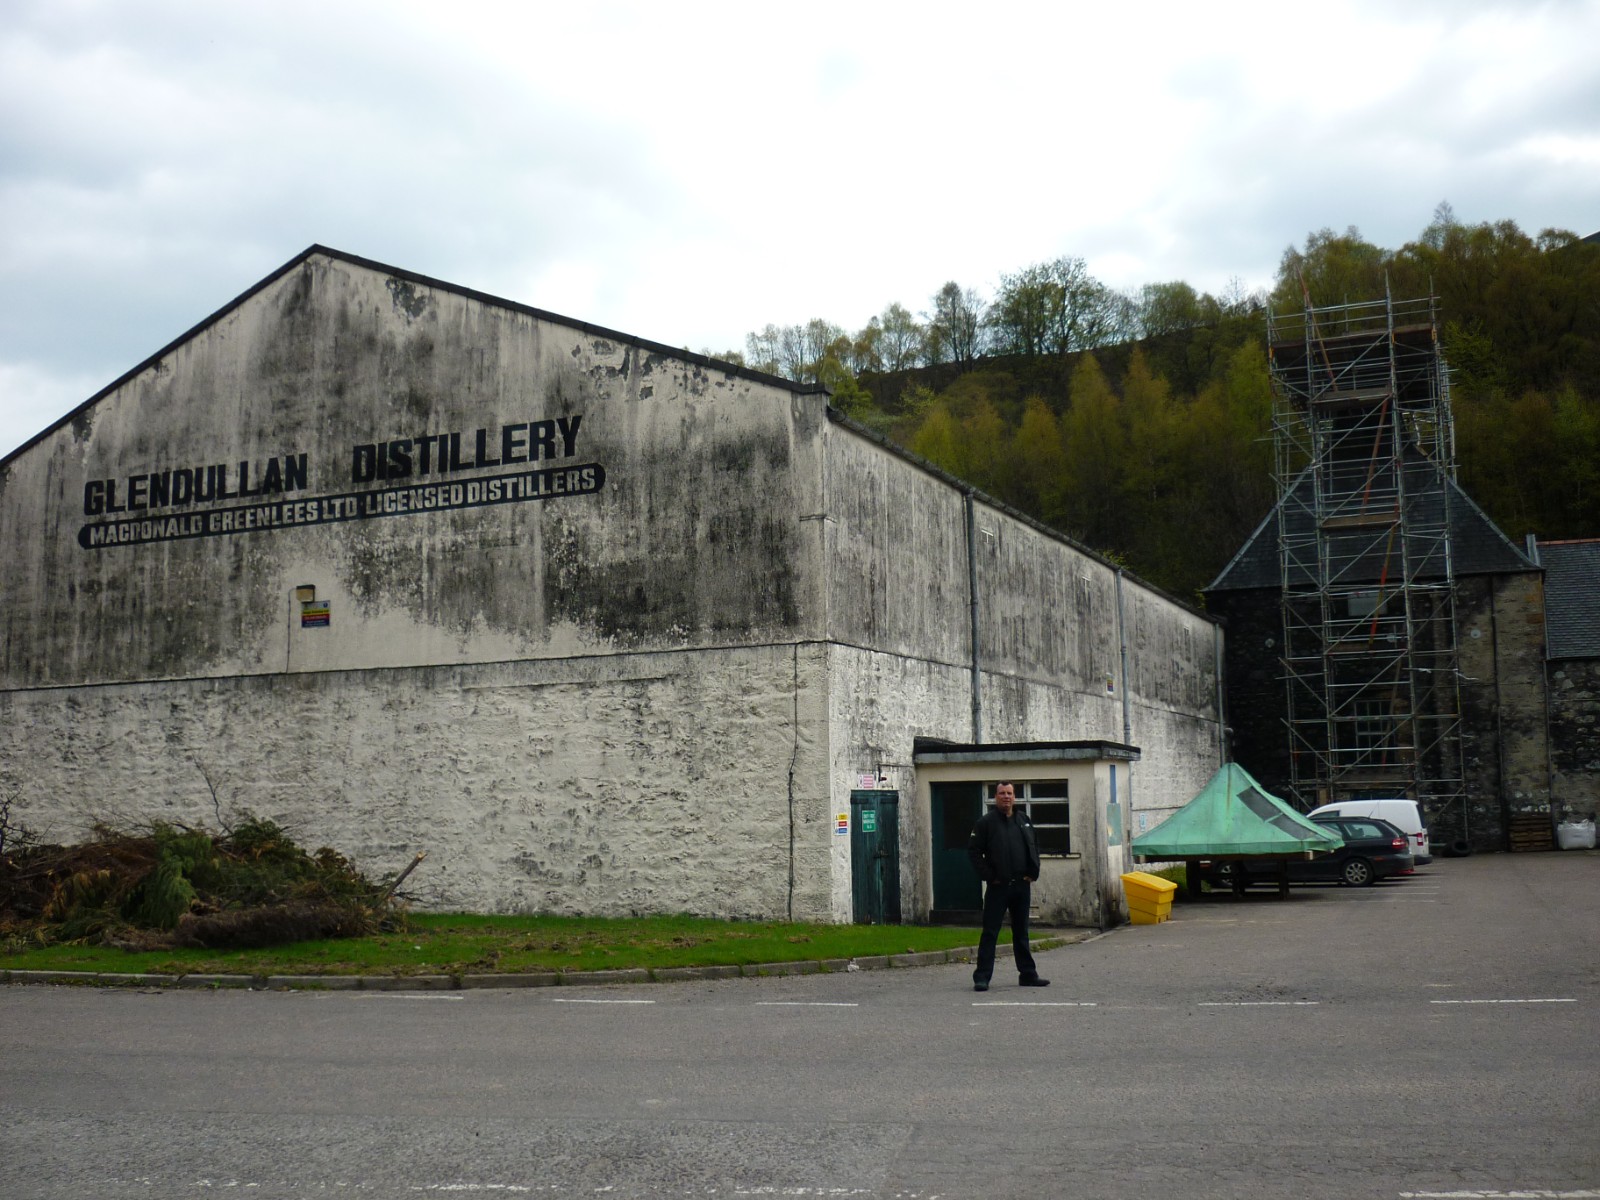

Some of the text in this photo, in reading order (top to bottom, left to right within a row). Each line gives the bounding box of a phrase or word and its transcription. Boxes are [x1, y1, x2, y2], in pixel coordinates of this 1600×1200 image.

[84, 415, 582, 515] GLENDULLAN DISTILLERY
[90, 467, 596, 545] MACDONALD GREENLEES LTD LICENSED DISTILLERS
